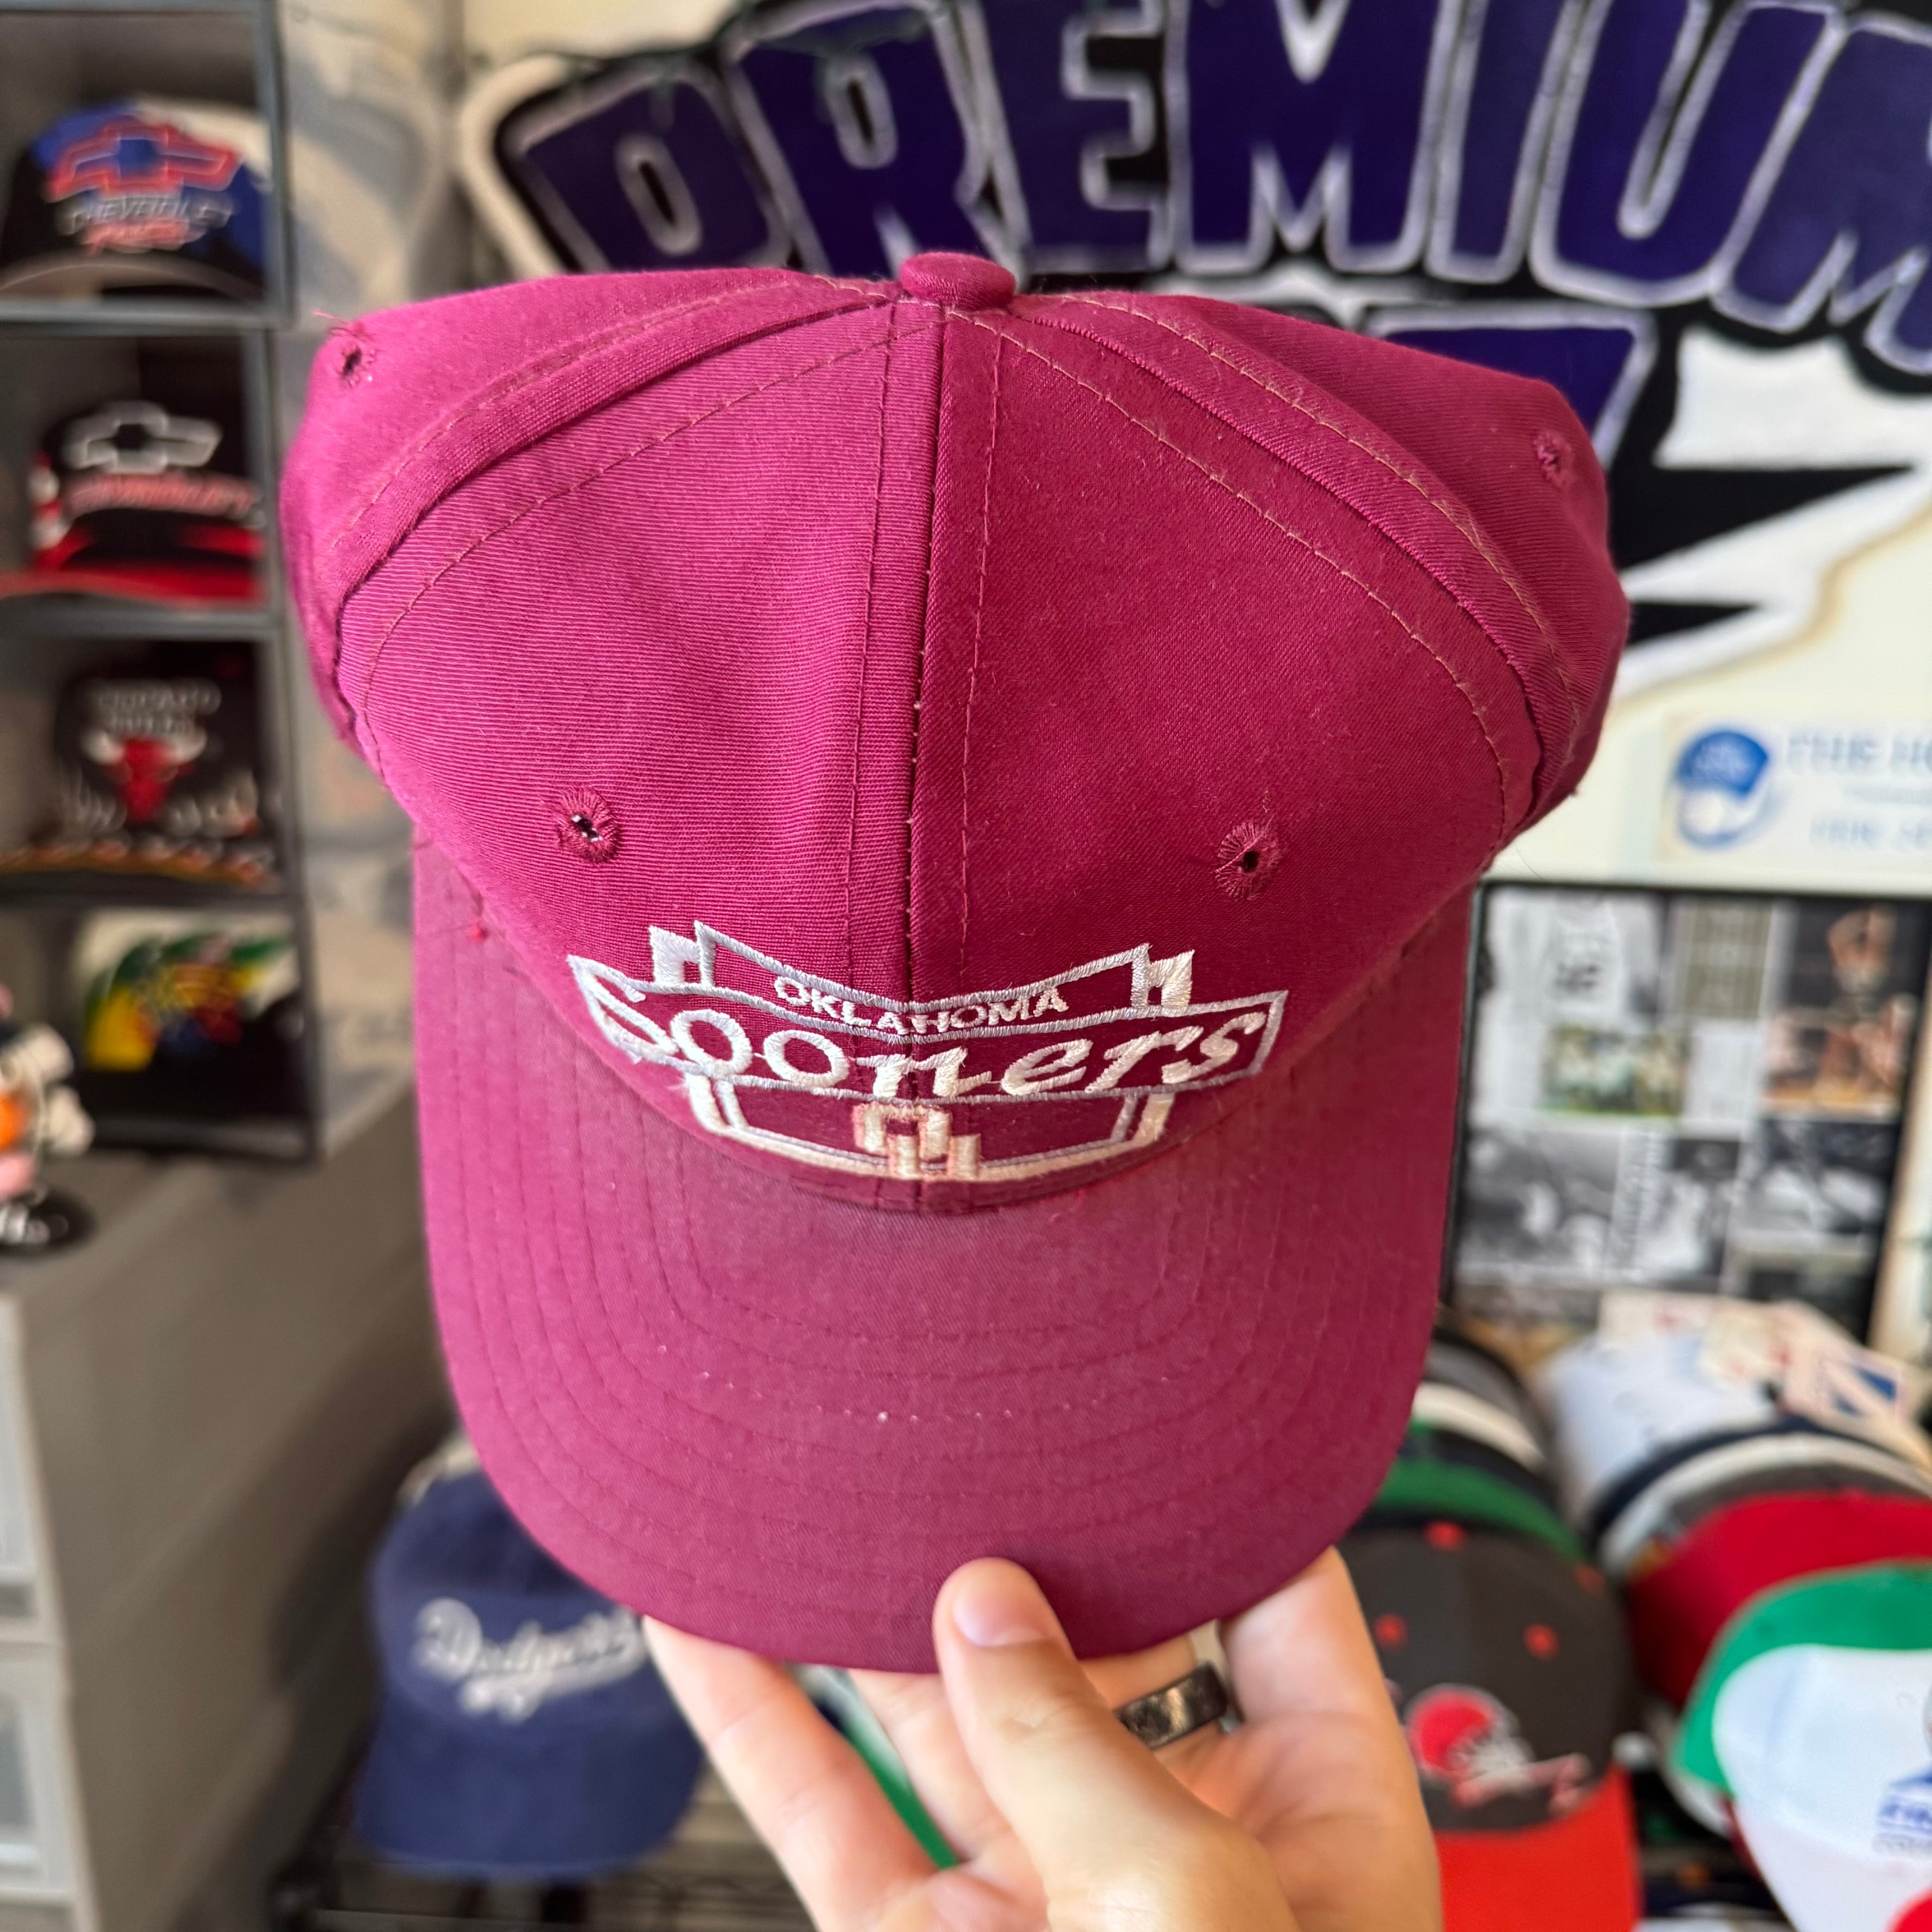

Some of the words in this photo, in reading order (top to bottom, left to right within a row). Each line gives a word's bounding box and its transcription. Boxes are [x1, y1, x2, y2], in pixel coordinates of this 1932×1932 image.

[496, 0, 1932, 375] PREMIUM
[579, 960, 1266, 1098] Sooners
[774, 976, 1070, 1035] OKLAHOMA
